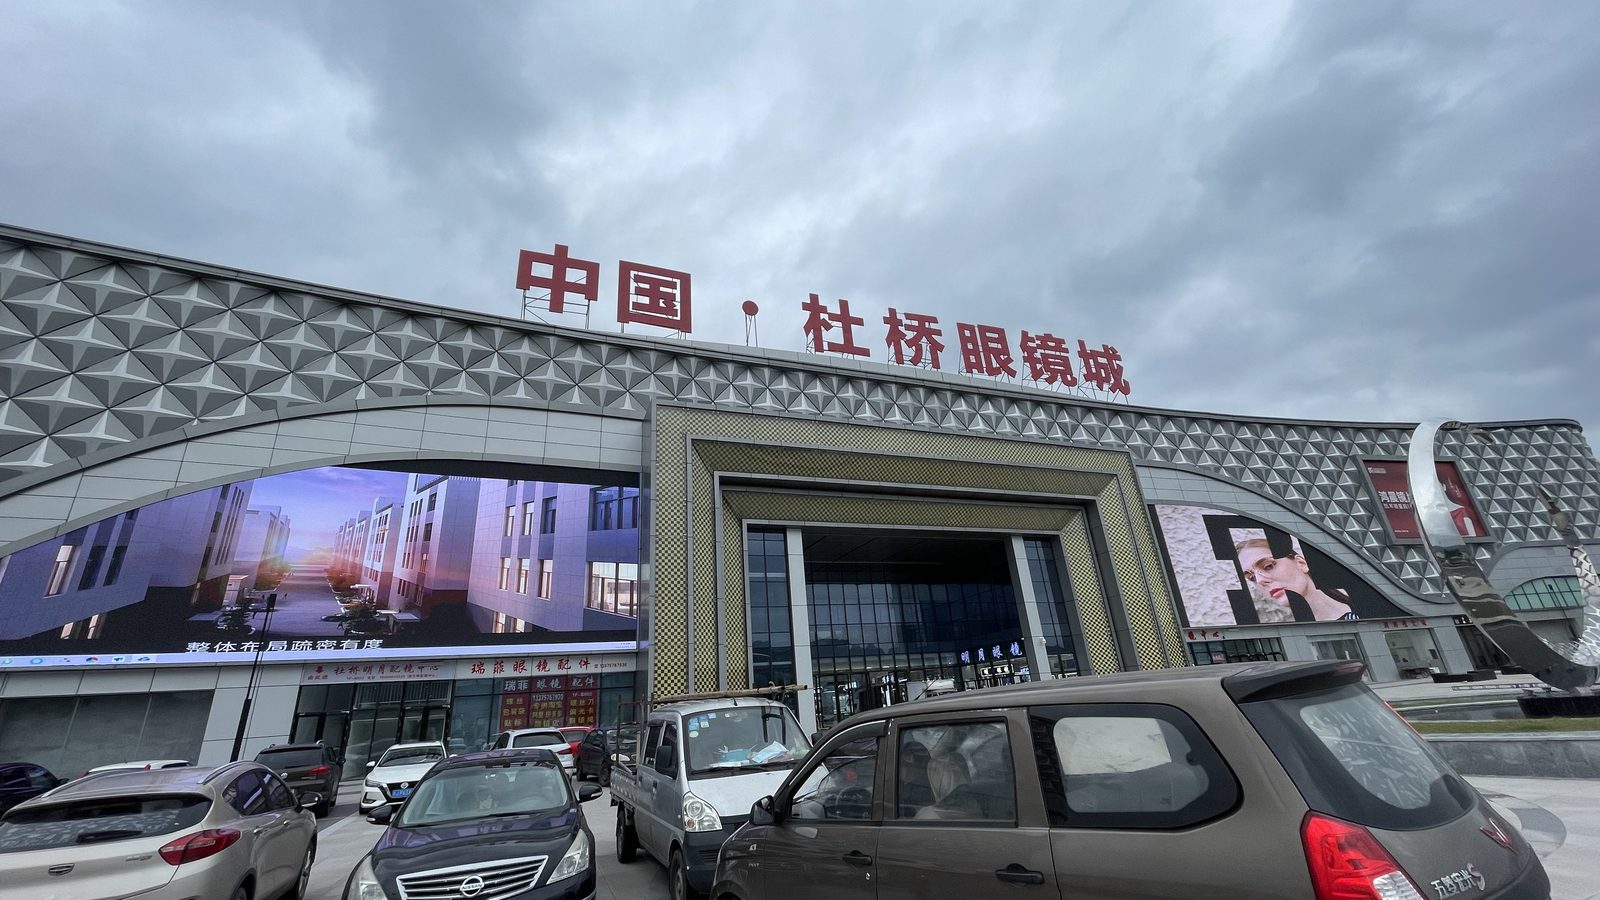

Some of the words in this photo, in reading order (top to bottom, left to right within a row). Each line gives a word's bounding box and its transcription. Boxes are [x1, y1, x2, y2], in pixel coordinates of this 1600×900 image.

[185, 639, 384, 653] 整体布局疏密有度
[961, 641, 1023, 664] 明月眼镜
[471, 658, 591, 674] 瑞菲眼镜配件
[1430, 862, 1486, 899] 五菱宏光S
